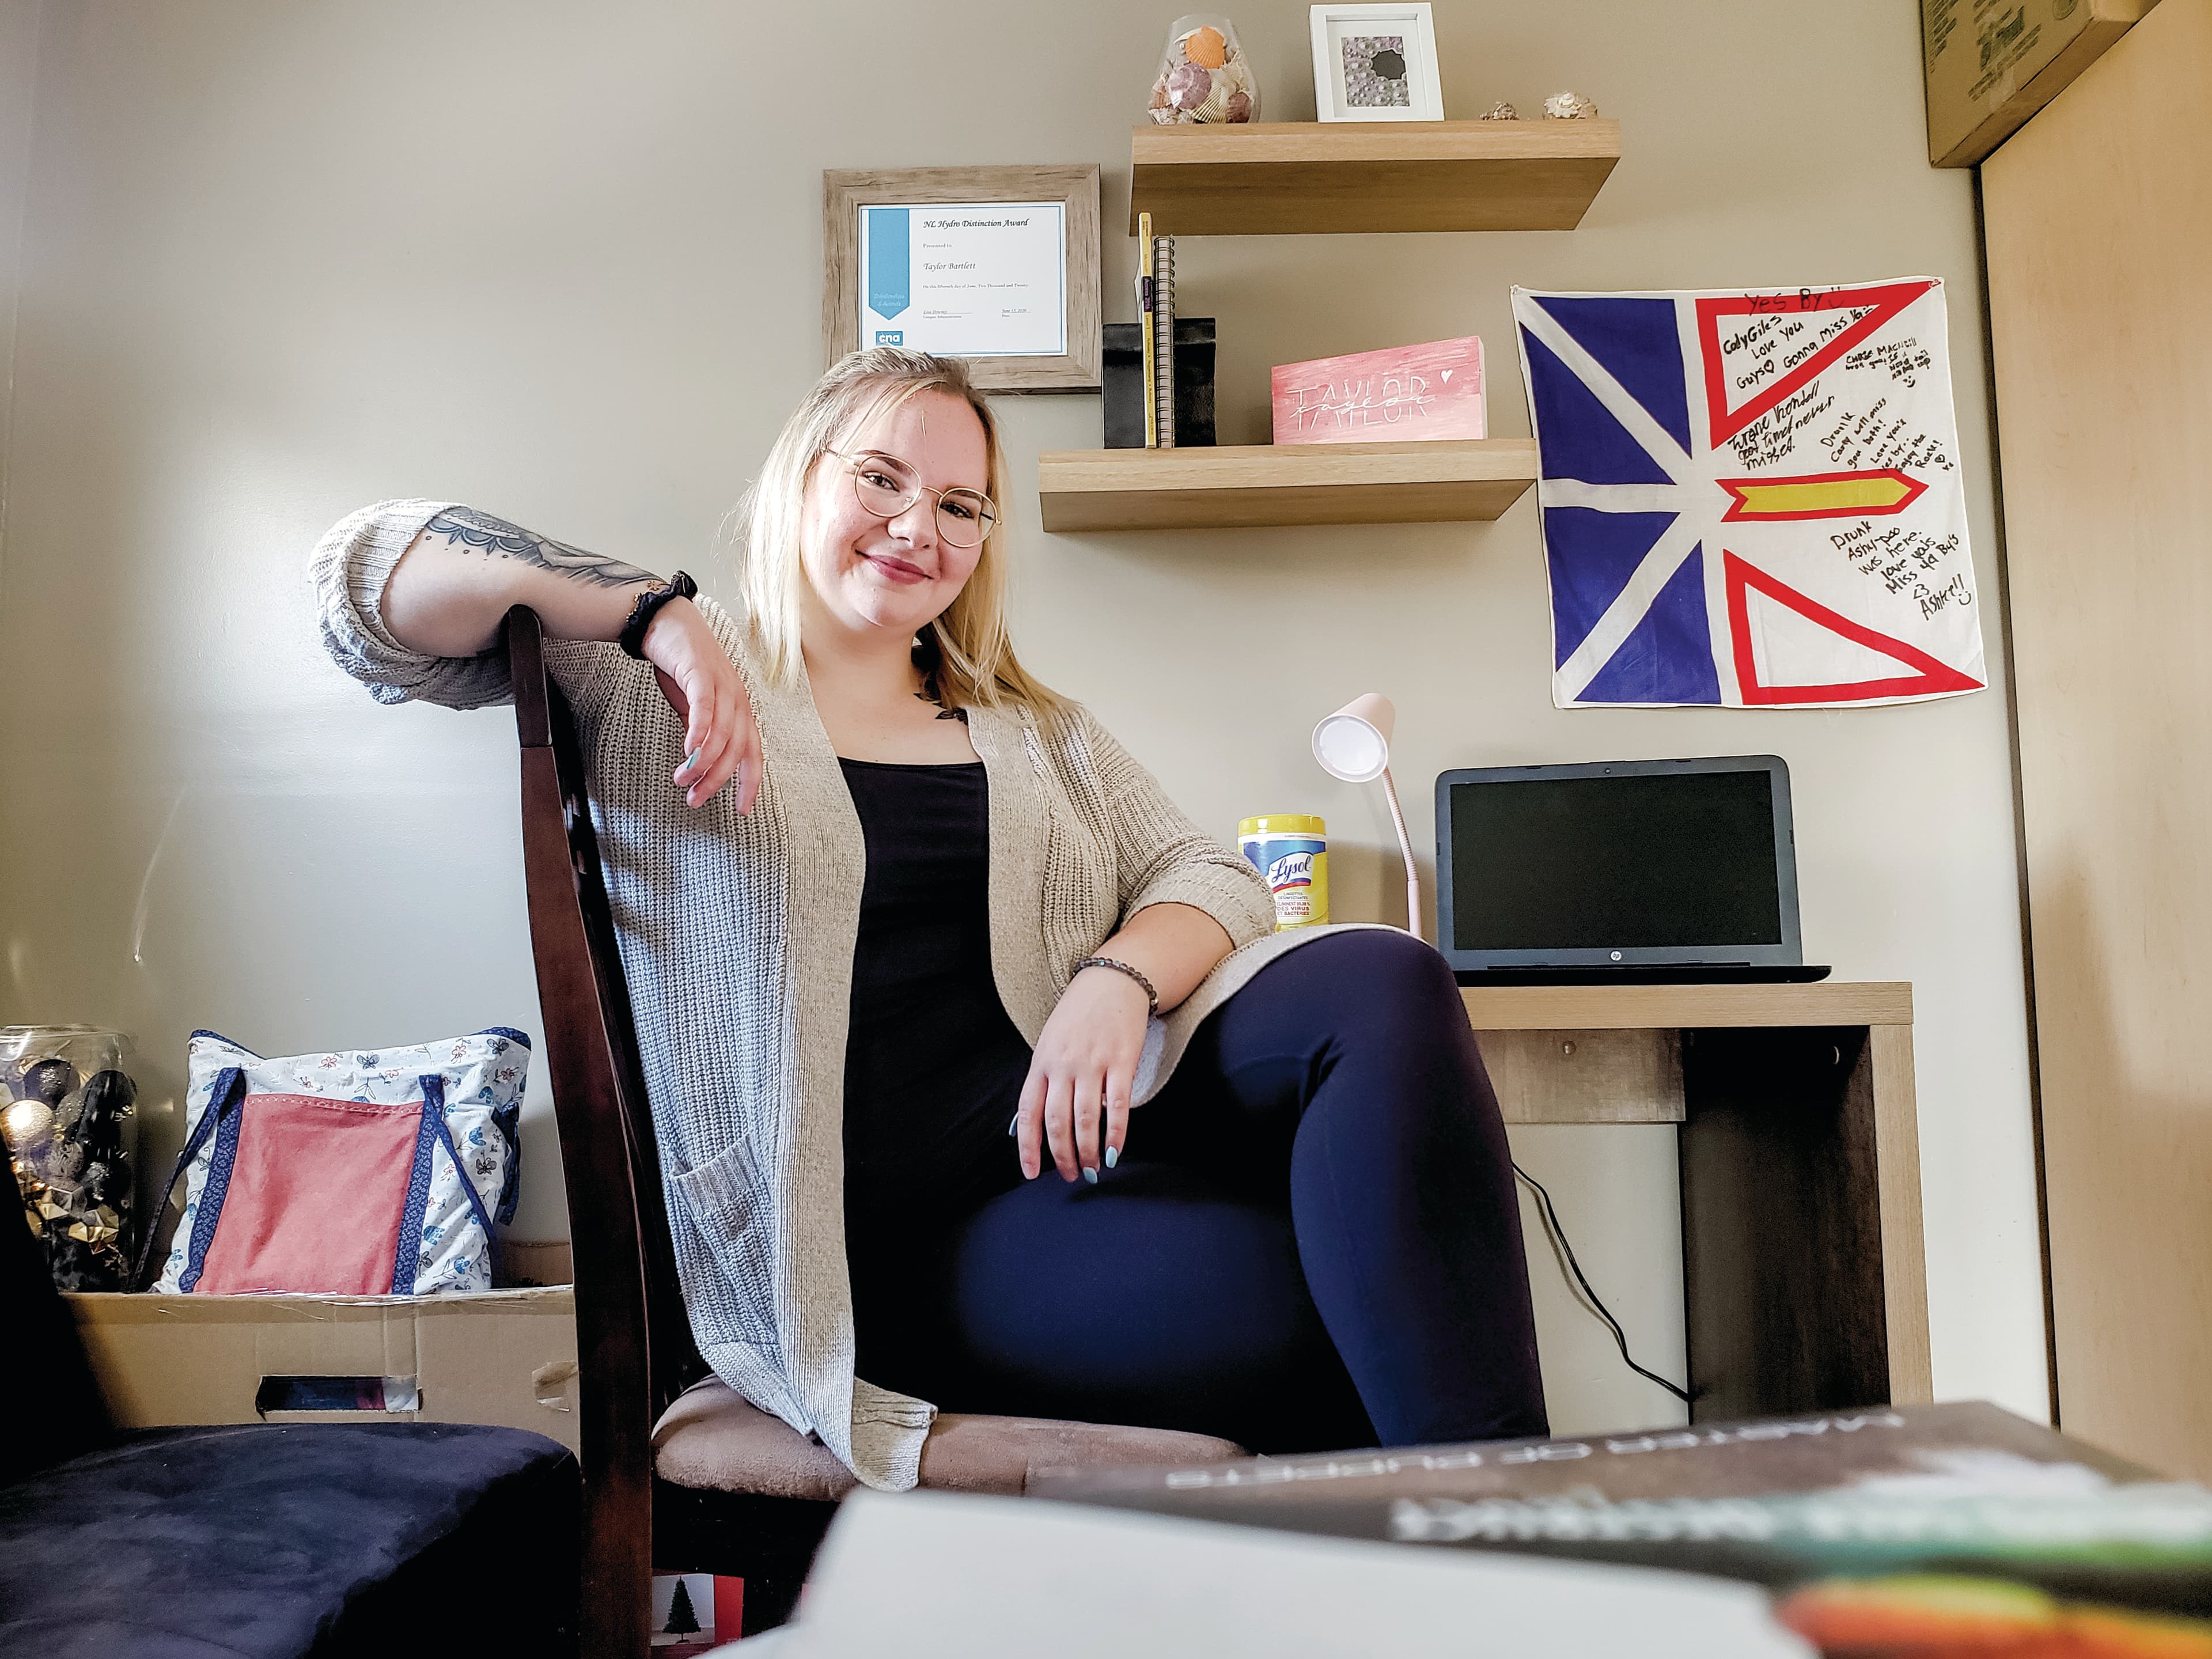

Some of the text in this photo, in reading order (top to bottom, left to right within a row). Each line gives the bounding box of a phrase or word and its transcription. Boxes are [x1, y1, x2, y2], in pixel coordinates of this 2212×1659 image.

[937, 220, 960, 230] Hydro
[961, 219, 1002, 228] Distinction
[1002, 218, 1030, 228] Award
[923, 261, 976, 272] Taylor Bartlett
[878, 334, 900, 343] cna
[1783, 342, 1819, 369] Gonna
[1820, 316, 1847, 342] Miss
[1830, 520, 1872, 550] Drunk
[1271, 855, 1311, 882] Lysol
[1499, 1442, 1592, 1464] OF
